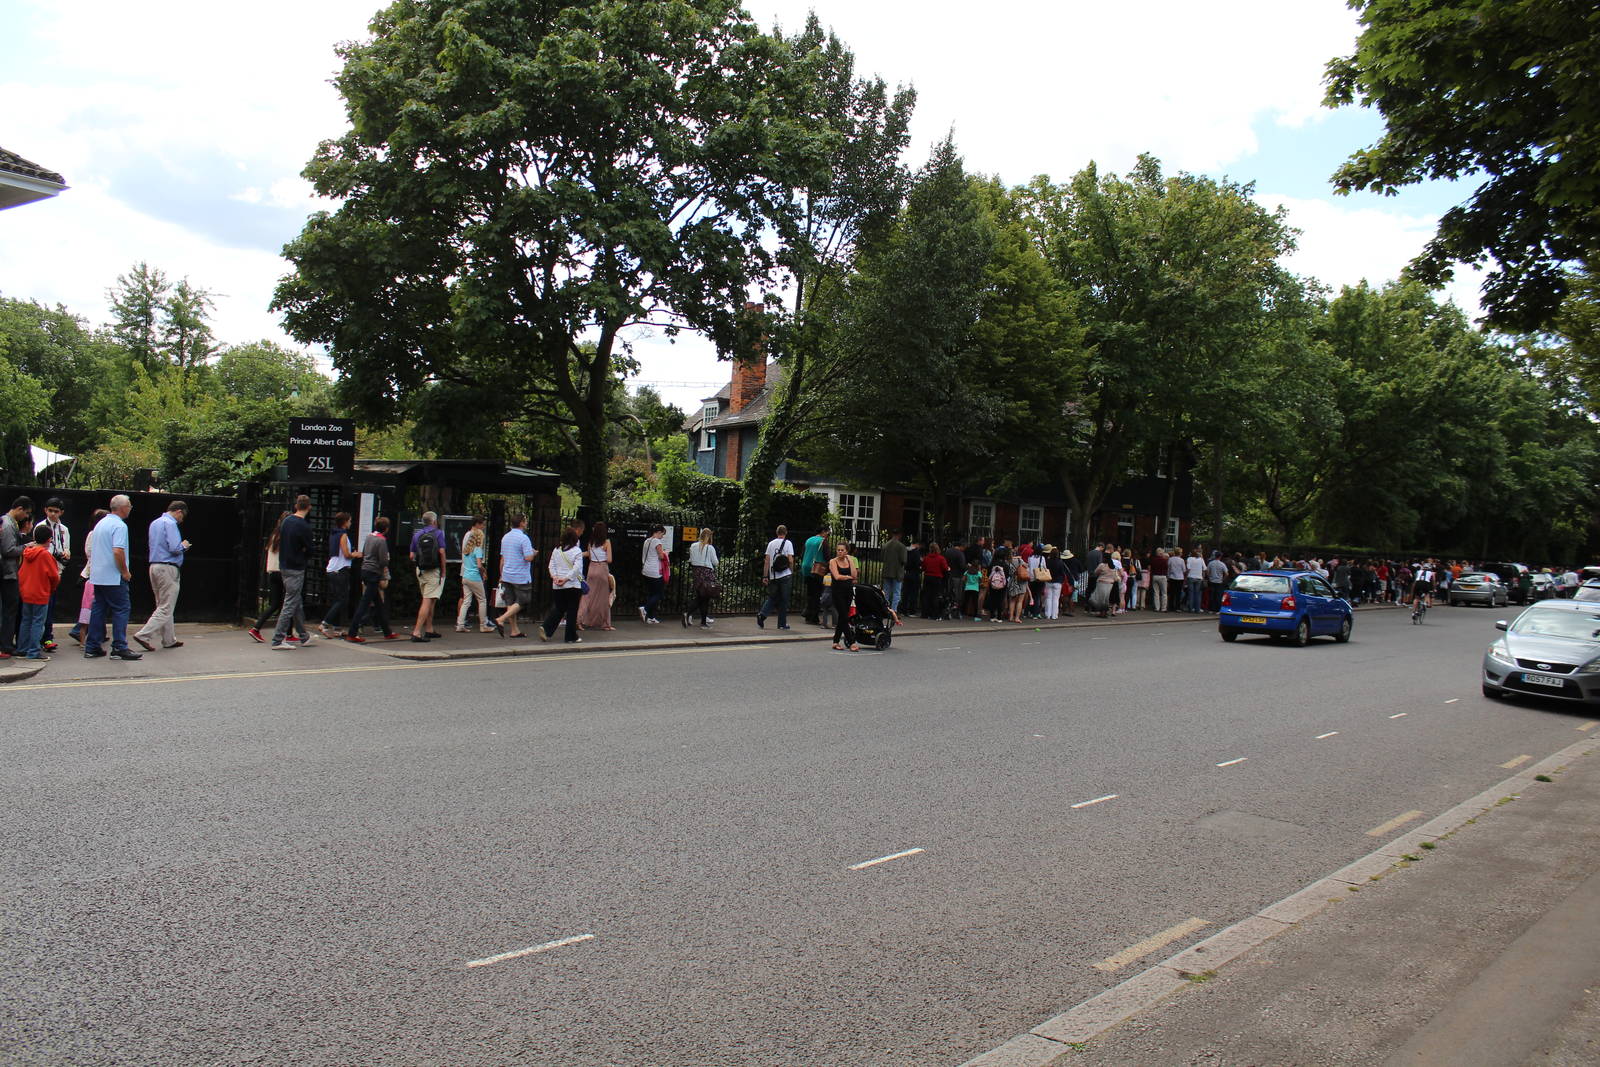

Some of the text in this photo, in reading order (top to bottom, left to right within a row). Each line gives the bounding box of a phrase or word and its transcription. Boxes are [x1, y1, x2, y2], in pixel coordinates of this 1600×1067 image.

[301, 423, 342, 432] London Zoo
[290, 437, 354, 447] Prince Albert Gate
[308, 456, 334, 470] ZSL
